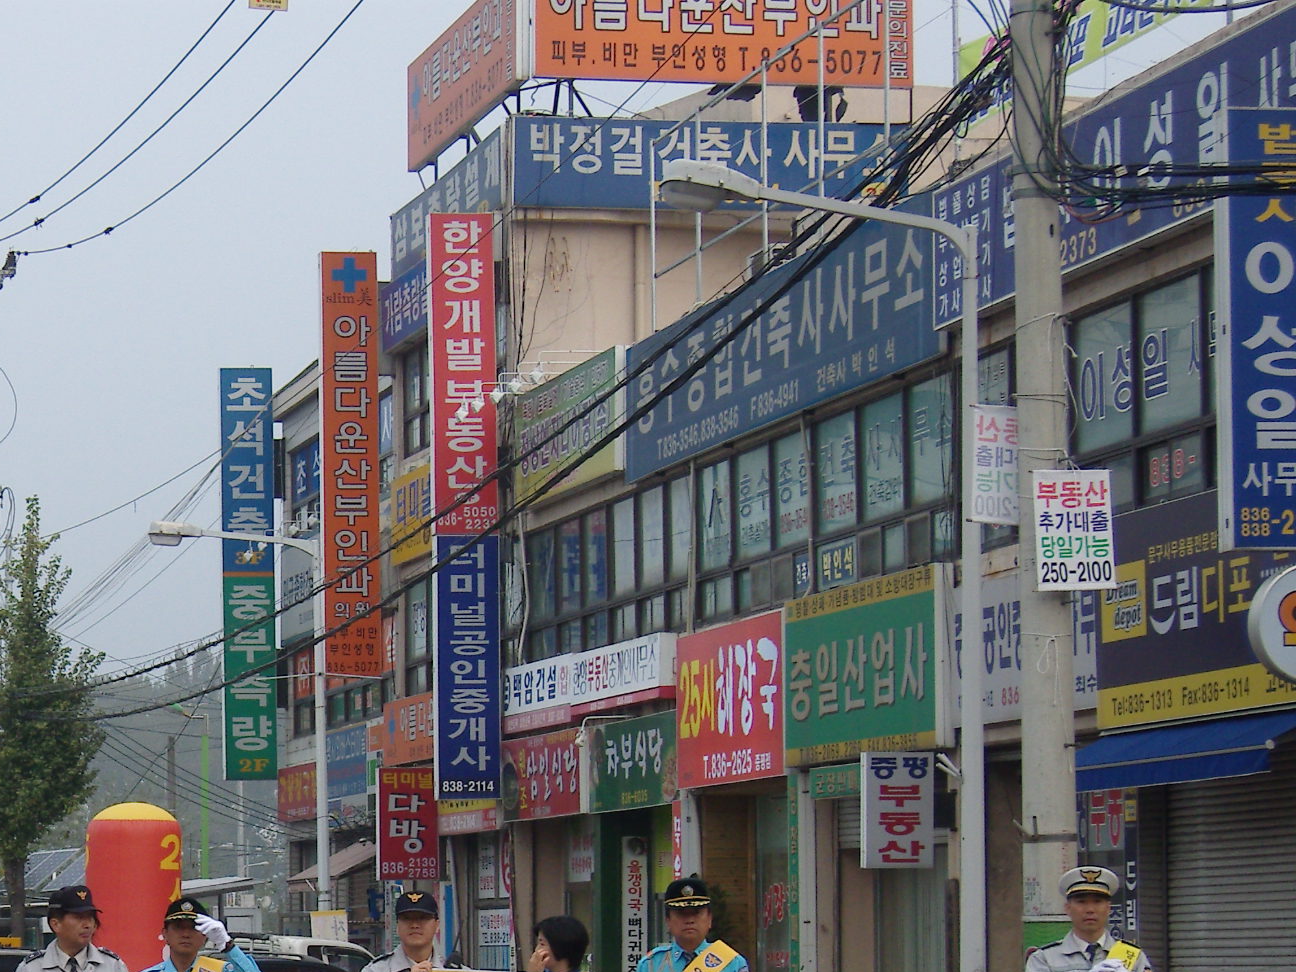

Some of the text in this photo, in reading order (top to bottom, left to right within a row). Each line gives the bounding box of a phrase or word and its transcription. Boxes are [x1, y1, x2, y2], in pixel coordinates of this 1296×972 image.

[528, 121, 647, 176] 박정걸
[442, 220, 488, 504] 한양개발부동산
[333, 315, 373, 598] 아름다운산부인과
[1037, 480, 1110, 509] 부동산
[1039, 510, 1110, 534] 추가대출
[1240, 506, 1271, 522] 836
[1040, 535, 1111, 559] 당일가능
[1041, 560, 1113, 584] 250-2100
[333, 601, 370, 619] 의원
[228, 583, 273, 752] 중부측량
[447, 543, 492, 772] 터미널공인중개사
[790, 621, 928, 723] 충일산업사
[238, 757, 270, 773] 2F
[605, 727, 664, 780] 차부식당
[382, 771, 434, 790] 터미널
[869, 757, 930, 780] 증평
[441, 779, 495, 793] 838-2114
[387, 793, 427, 854] 다방
[877, 784, 926, 864] 부동산
[407, 867, 437, 880] 2758
[408, 856, 437, 868] 2130
